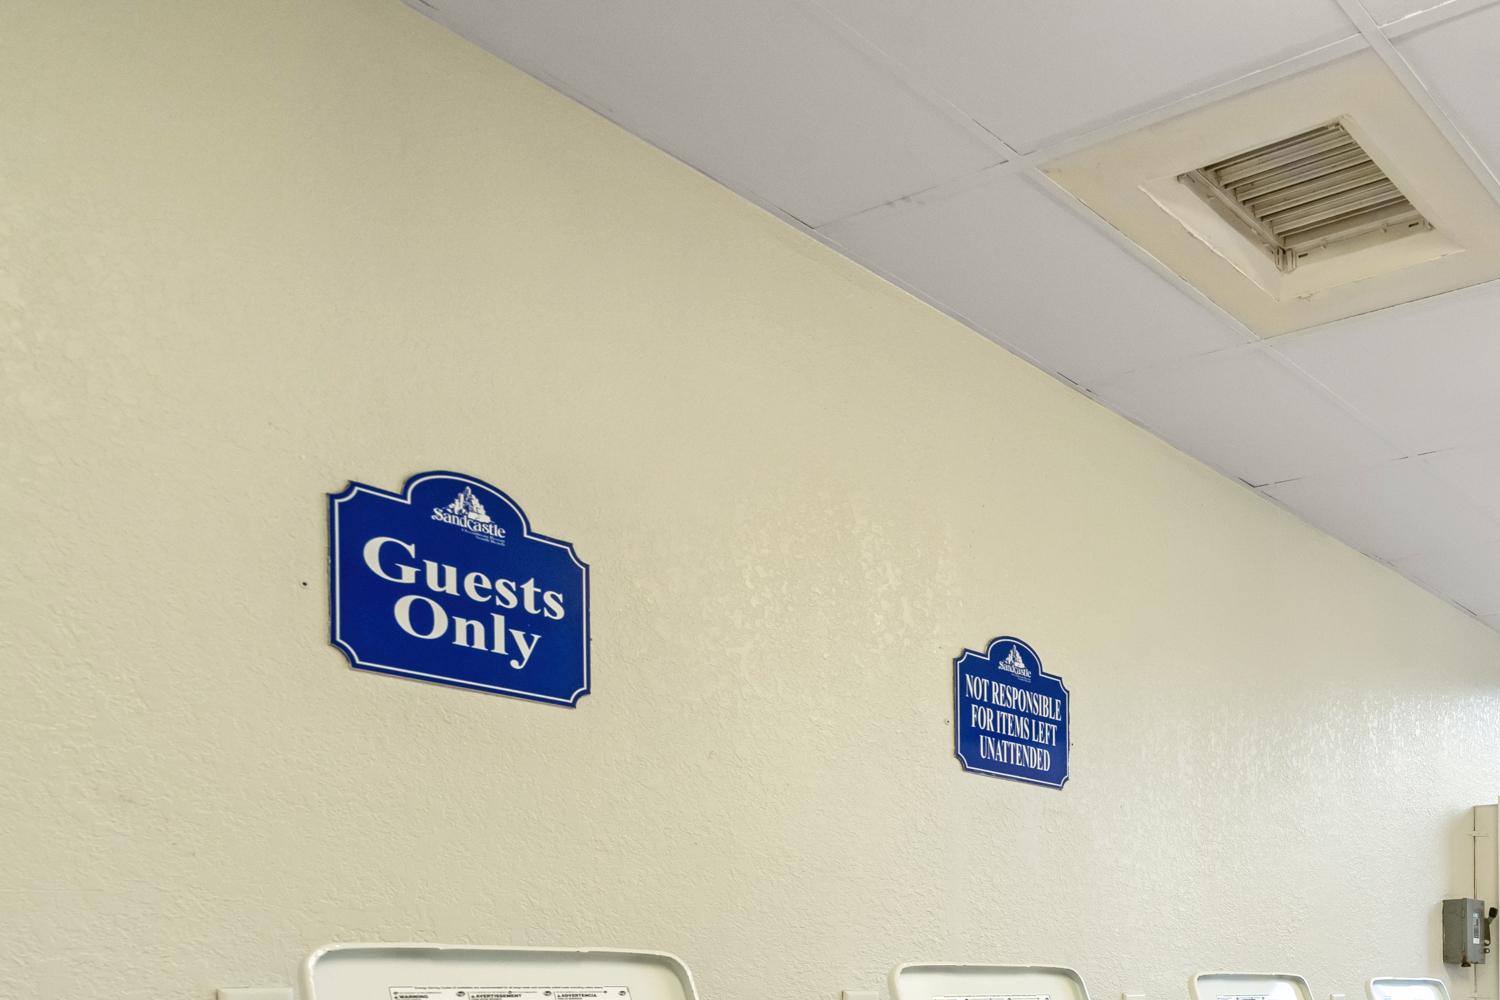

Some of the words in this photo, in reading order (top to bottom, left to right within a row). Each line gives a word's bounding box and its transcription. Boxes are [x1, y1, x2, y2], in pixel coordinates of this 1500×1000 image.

[430, 507, 506, 539] Sandcastle
[363, 536, 565, 620] Guests
[394, 594, 542, 669] Only
[965, 673, 989, 702] NOT
[991, 680, 1062, 721] RESPONSIBLE
[971, 704, 995, 732] FOR
[996, 710, 1030, 740] ITEMS
[1032, 719, 1058, 746] LEFT
[979, 734, 1050, 771] UNATTENDED
